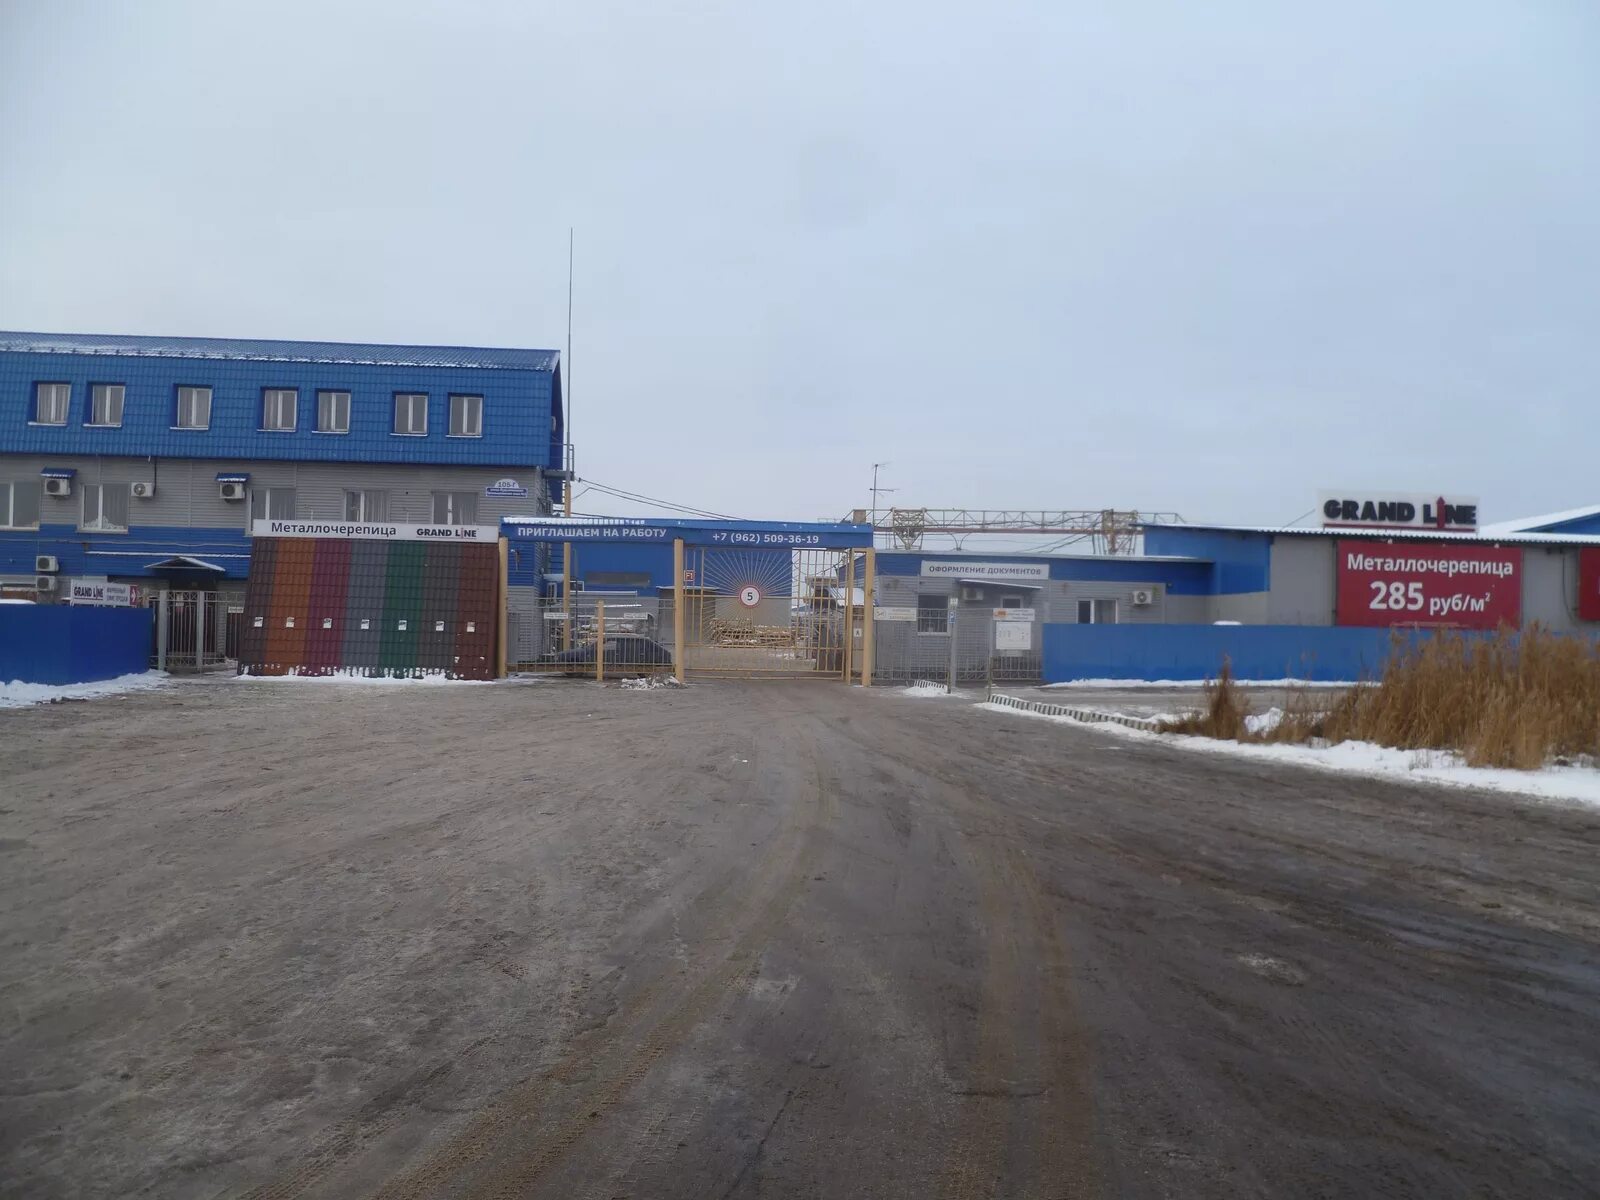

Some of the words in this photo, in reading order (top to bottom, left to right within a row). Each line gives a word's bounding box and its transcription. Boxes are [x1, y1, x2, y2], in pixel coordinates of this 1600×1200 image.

[1324, 499, 1416, 522] GRAND
[1423, 496, 1477, 528] LINE
[271, 521, 397, 537] Металлочерепица
[416, 527, 453, 537] GRAND
[455, 527, 478, 539] LINE
[517, 526, 600, 539] ПРИГЛАШАЕМ
[603, 528, 619, 538] НА
[622, 528, 668, 539] РАБОТУ
[712, 533, 727, 543] +7
[730, 532, 760, 545] (962)
[763, 533, 820, 544] 509-36-19
[928, 565, 986, 575] ОФОРМЛЕНИЕ
[987, 566, 1042, 576] ДОКУМЕНТОВ
[1347, 553, 1513, 579] Металлочерепица
[73, 586, 93, 598] GRAND
[93, 585, 104, 599] LINE
[746, 592, 754, 601] 5
[1369, 581, 1424, 610] 285
